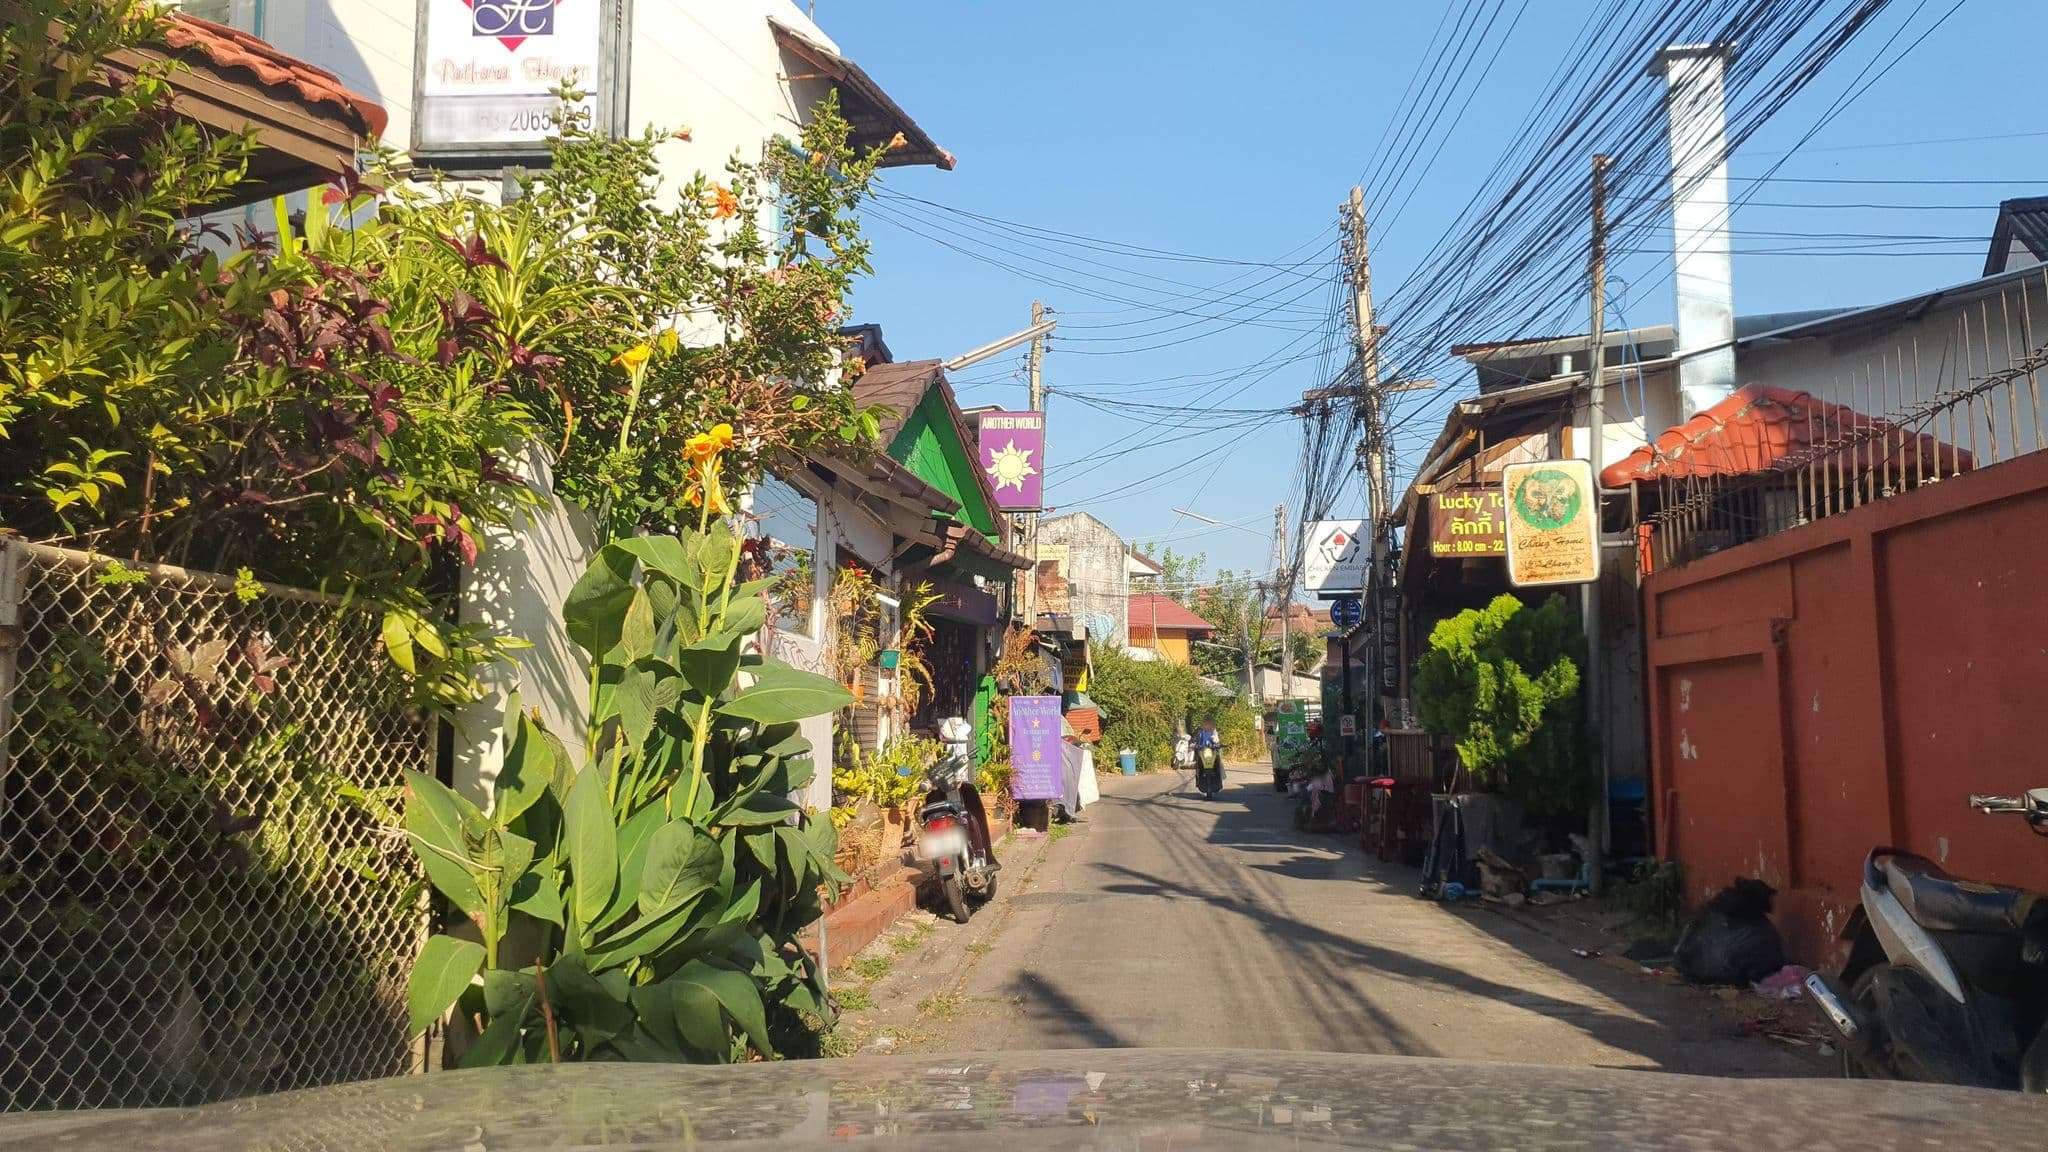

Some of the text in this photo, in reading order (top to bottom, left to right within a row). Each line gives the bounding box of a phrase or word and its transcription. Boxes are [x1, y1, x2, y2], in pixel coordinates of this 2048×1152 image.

[983, 416, 1041, 430] ANOTHER WORLD
[1439, 491, 1504, 514] Lucky To
[1433, 541, 1451, 552] Hour
[1456, 540, 1473, 552] 8.00
